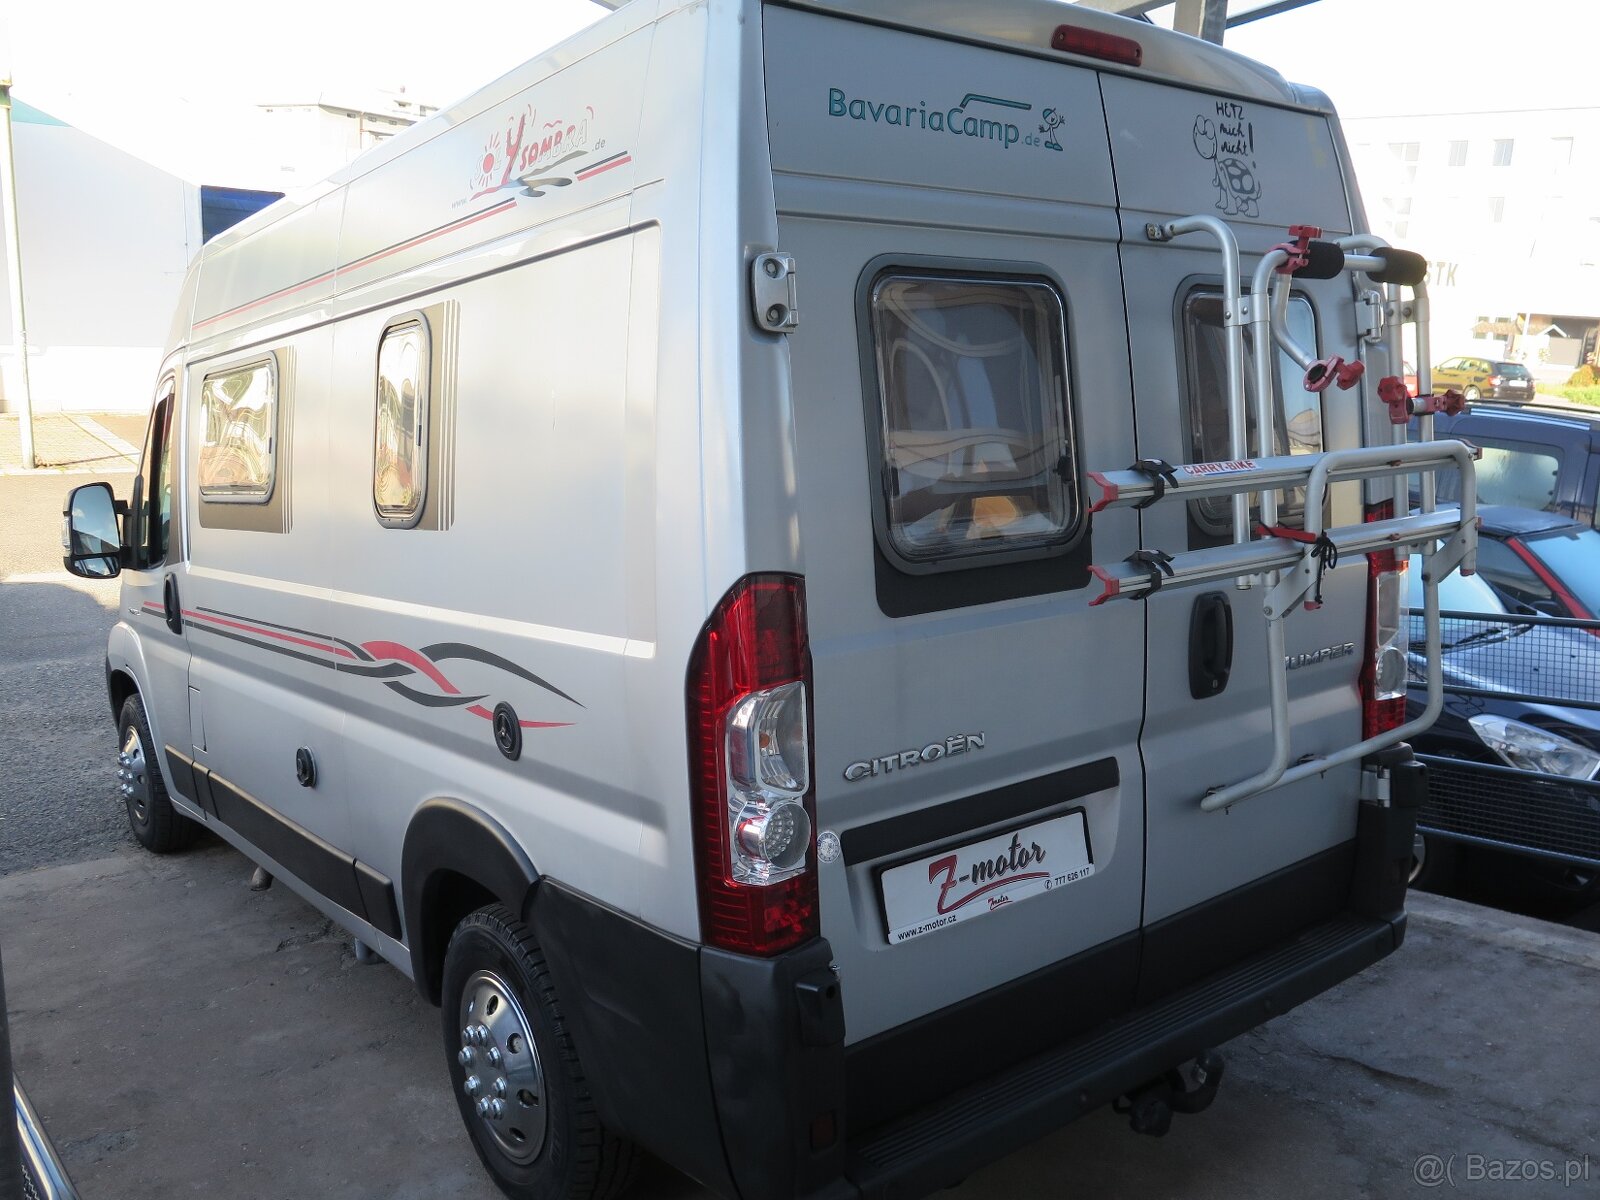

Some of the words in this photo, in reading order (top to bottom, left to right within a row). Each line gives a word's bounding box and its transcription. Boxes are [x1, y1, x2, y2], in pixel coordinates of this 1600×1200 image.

[828, 87, 1041, 149] BavariaCamp.de
[842, 730, 986, 782] CITROËN
[928, 831, 1049, 915] Z-motor
[1054, 876, 1067, 886] 777
[1067, 872, 1079, 883] 626
[1079, 867, 1090, 879] 117
[897, 914, 957, 941] www.z-motor.cz
